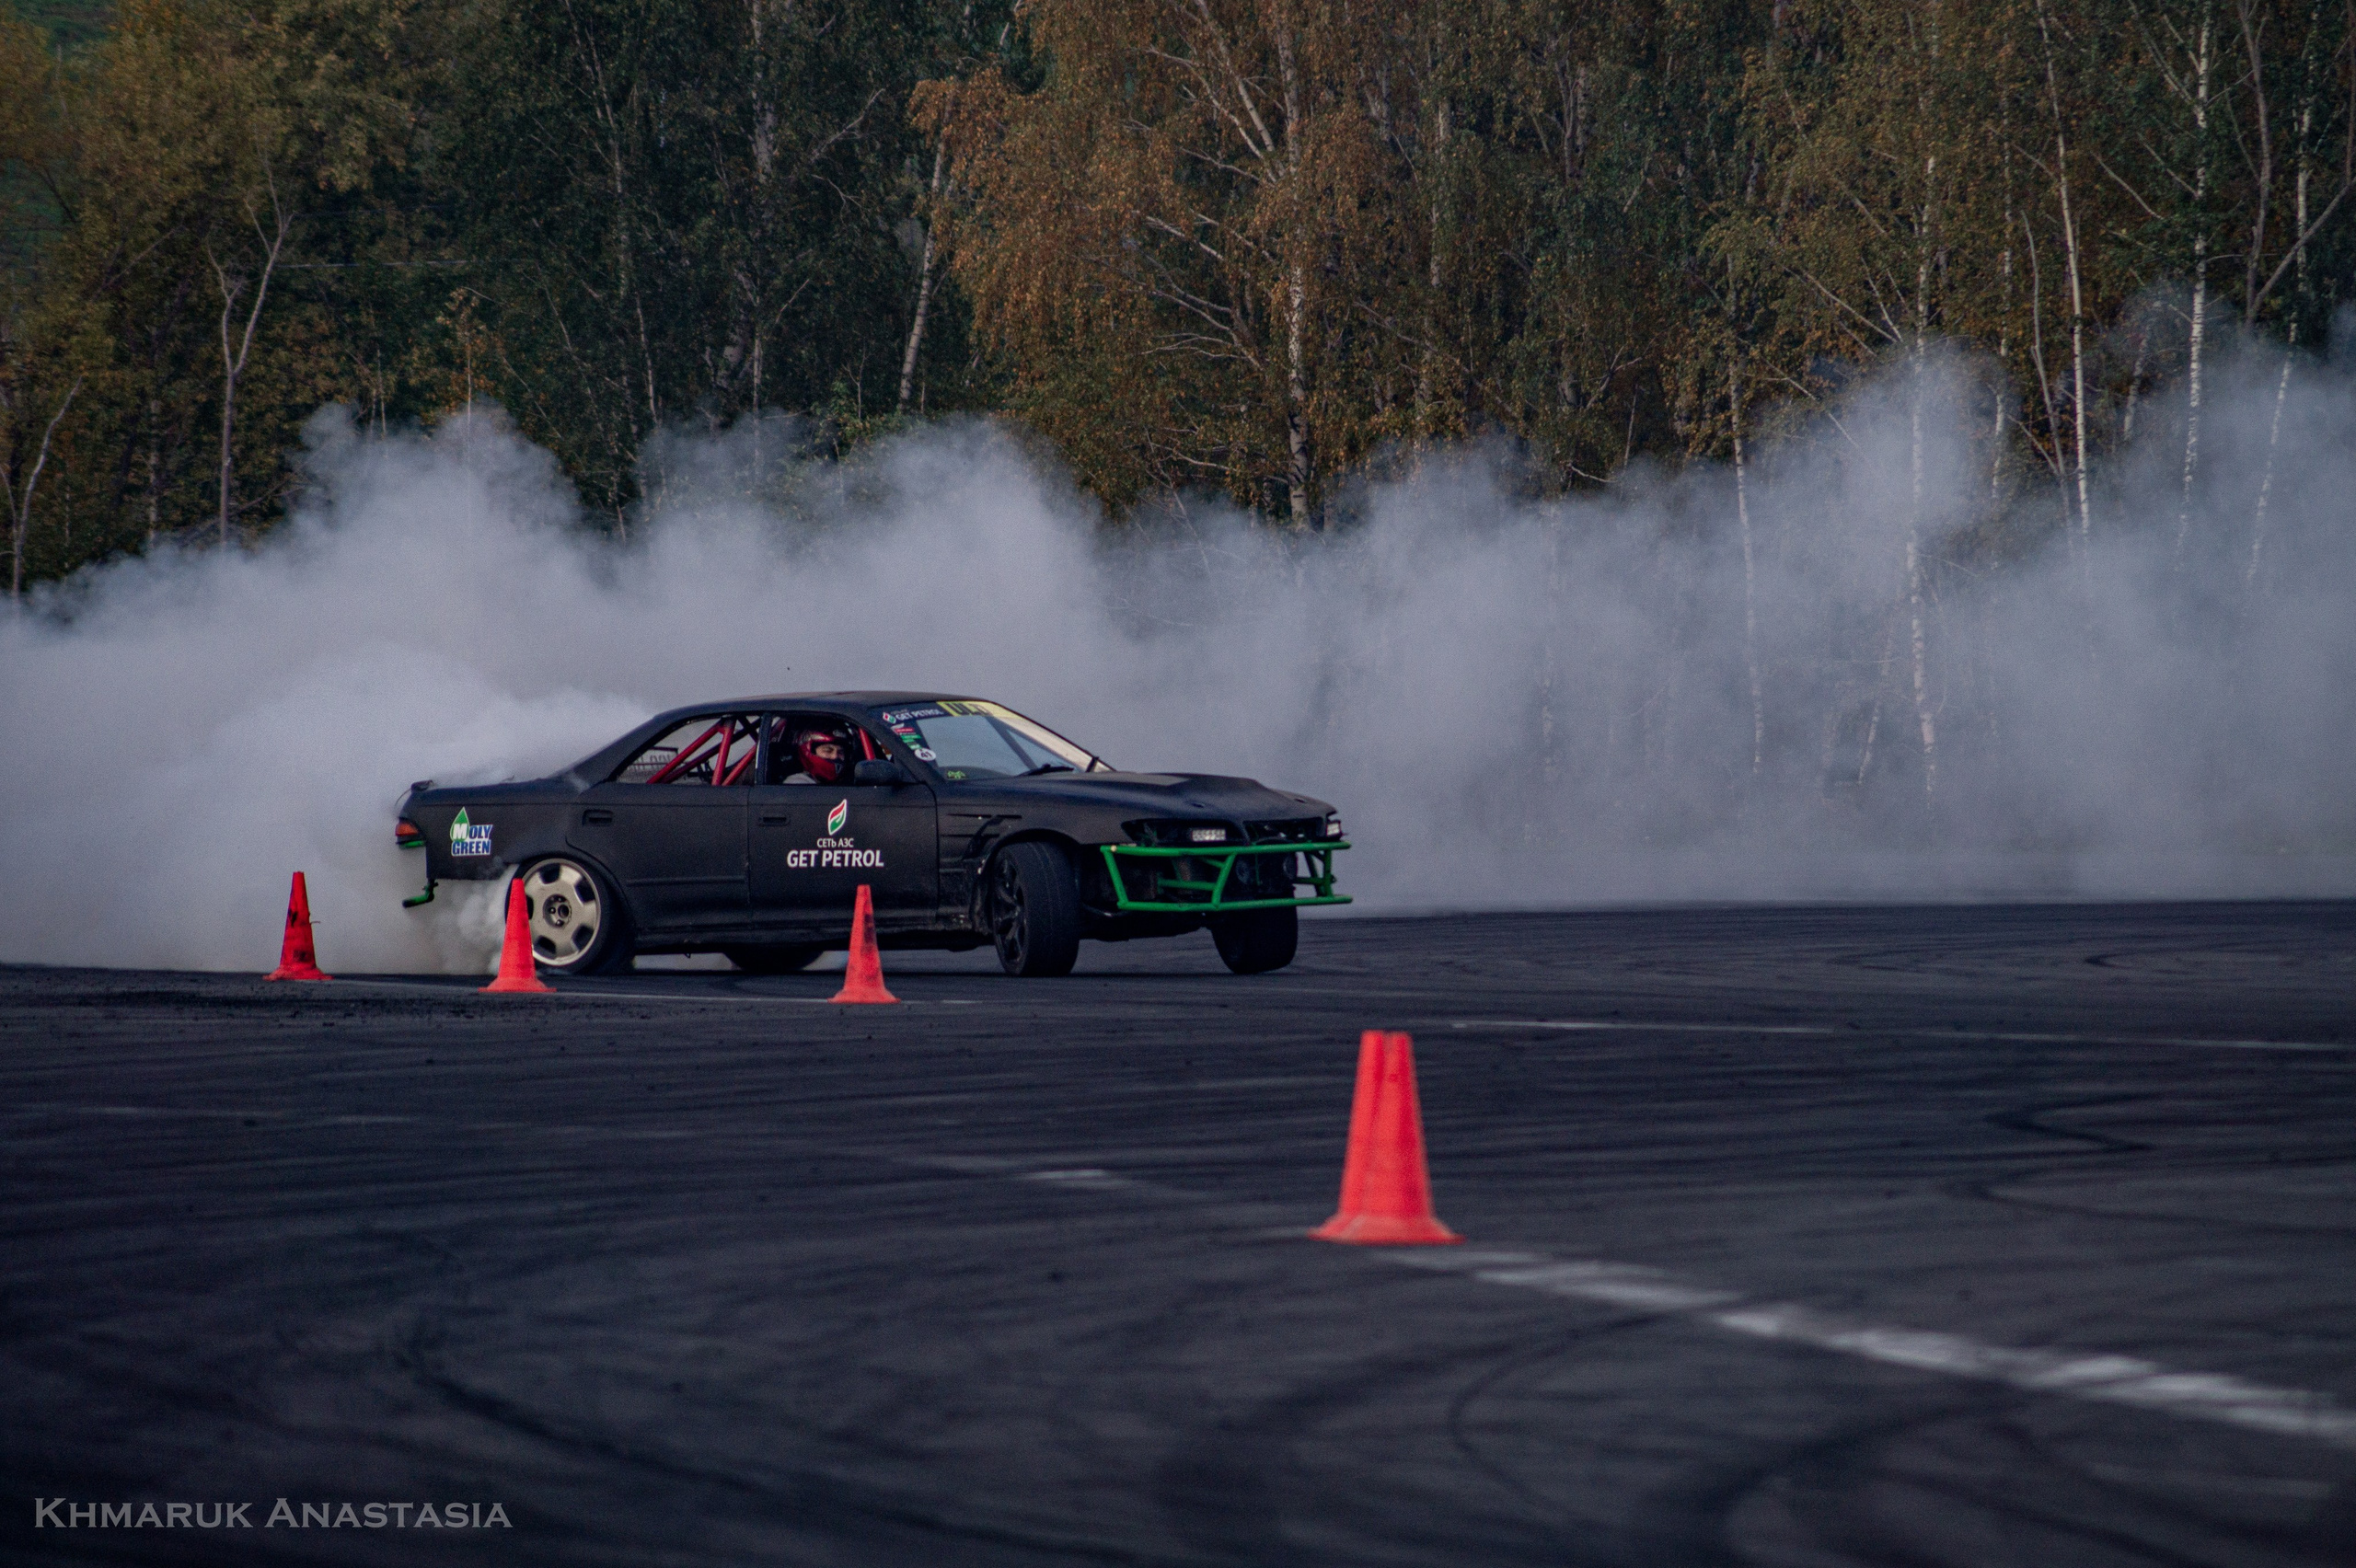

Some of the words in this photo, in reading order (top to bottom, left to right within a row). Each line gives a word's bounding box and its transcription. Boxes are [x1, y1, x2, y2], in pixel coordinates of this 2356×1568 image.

[452, 823, 492, 839] MOLY
[452, 840, 491, 855] GREEN
[787, 849, 818, 868] GET
[821, 849, 884, 868] PETROL
